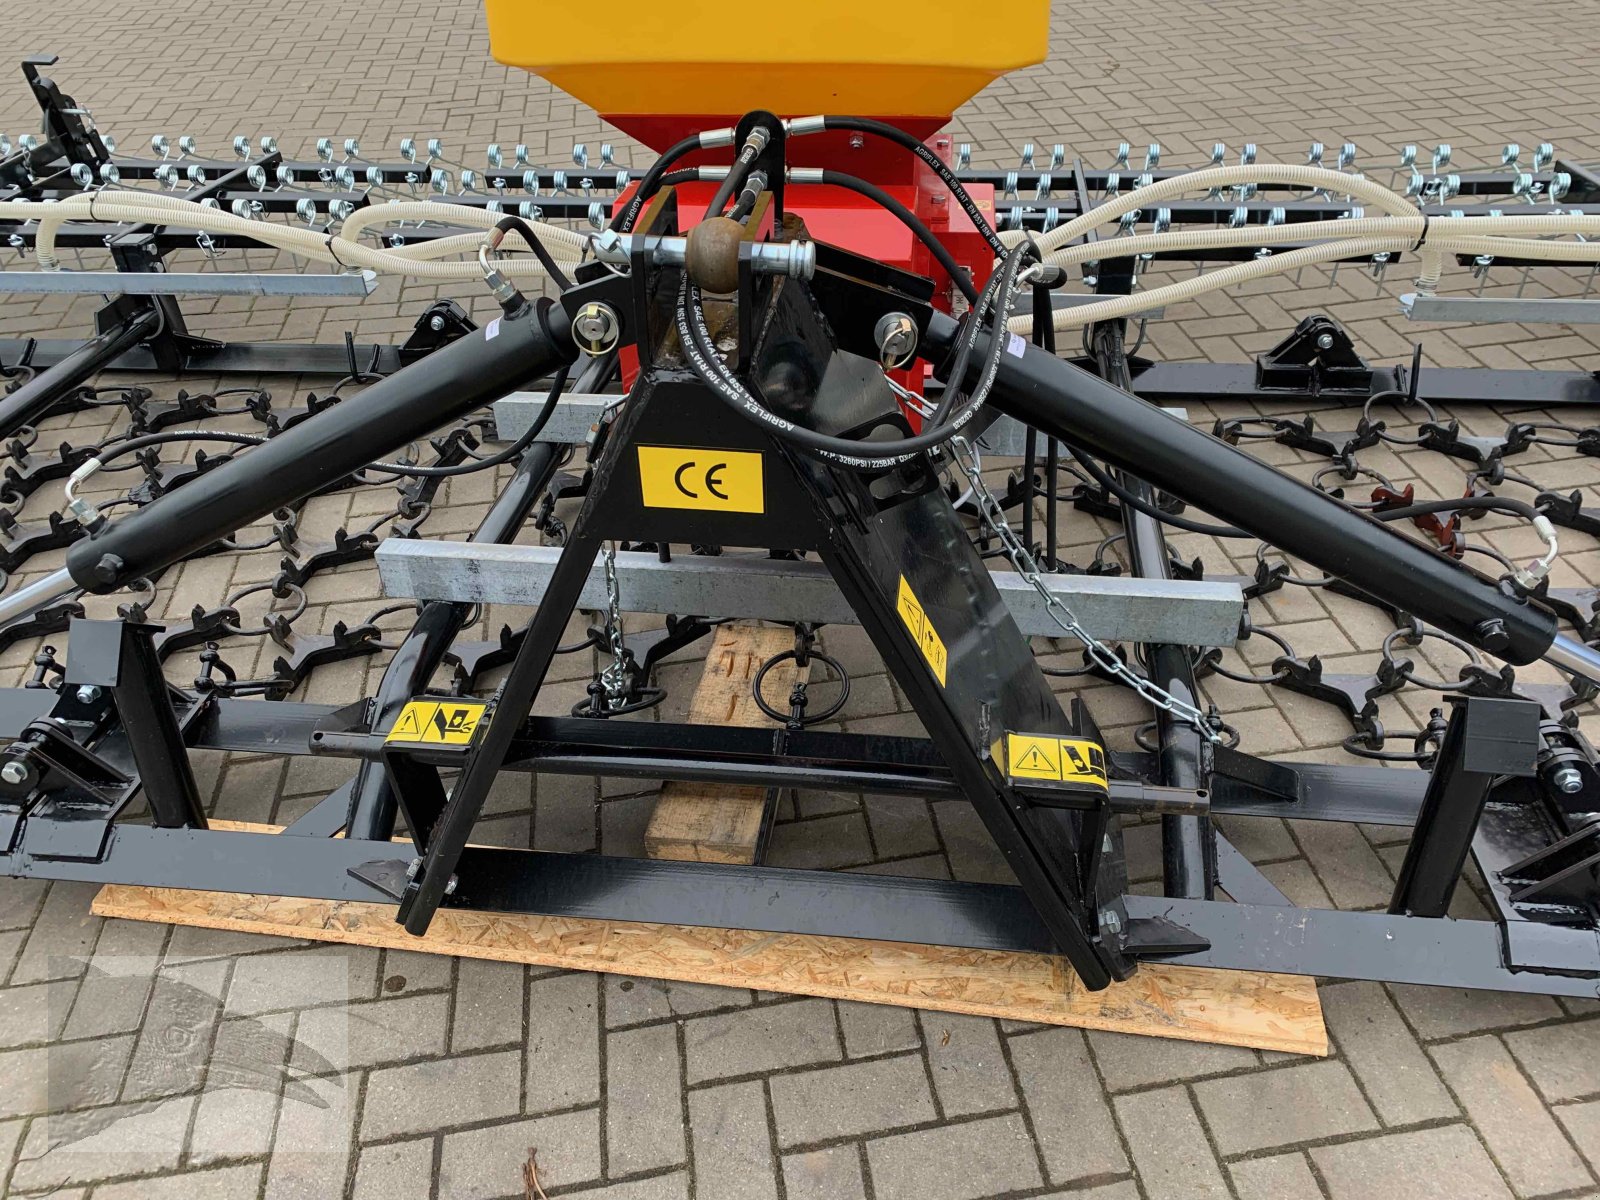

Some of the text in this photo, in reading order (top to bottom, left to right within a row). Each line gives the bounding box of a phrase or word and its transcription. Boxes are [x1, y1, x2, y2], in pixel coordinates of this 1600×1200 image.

[914, 146, 940, 169] AGRIFLEX
[940, 168, 952, 182] SAE
[949, 179, 959, 190] 100
[955, 187, 968, 205] R1AT
[967, 204, 977, 216] EN
[973, 213, 984, 226] 853
[989, 236, 1000, 248] DN
[622, 195, 642, 232] AGRIFLEX
[677, 295, 686, 306] DN
[693, 305, 704, 321] SAE
[679, 321, 689, 335] 853
[698, 322, 709, 336] 100
[969, 317, 983, 350] AGRIFLEX
[980, 302, 988, 316] SAE
[682, 334, 694, 346] EN
[703, 336, 720, 358] R1AT
[690, 351, 709, 371] R1AT
[706, 370, 720, 384] 100
[719, 364, 732, 377] EN
[720, 382, 740, 400] SAE
[744, 400, 795, 432] AGRIFLEX
[872, 457, 897, 468] 225BAR
[674, 461, 729, 500] CE
